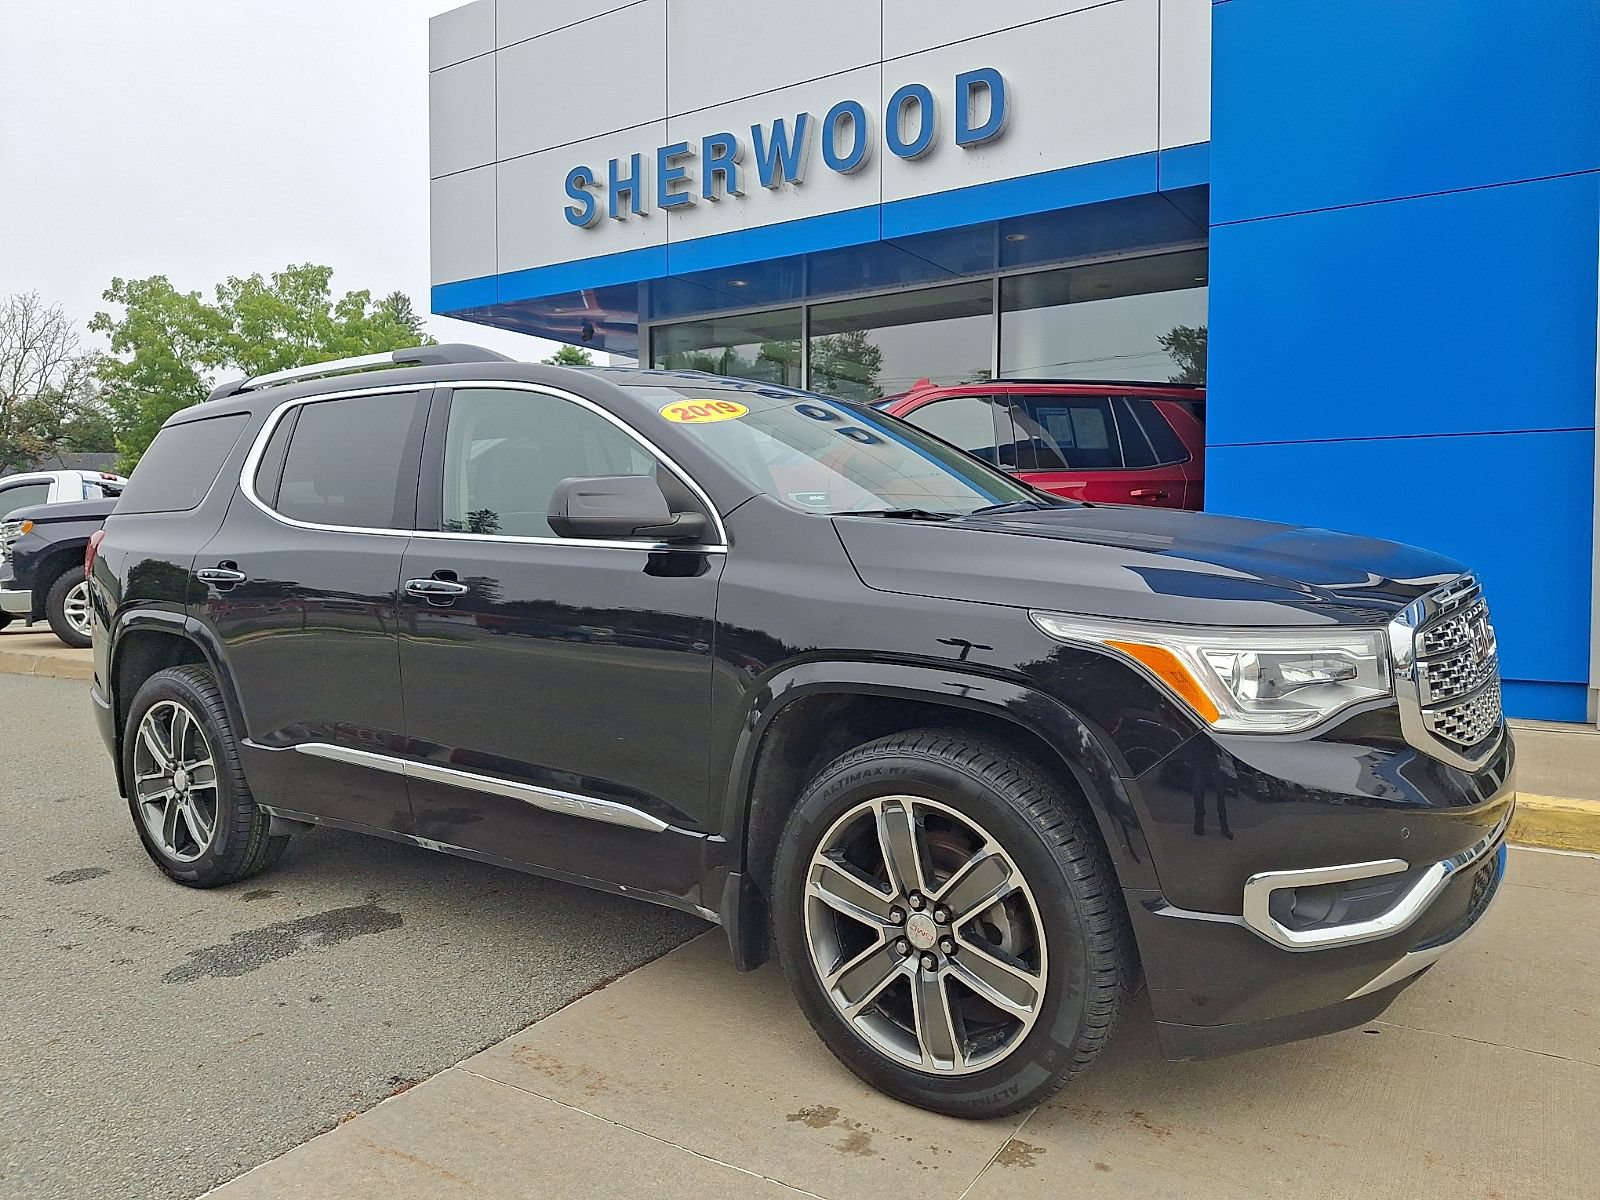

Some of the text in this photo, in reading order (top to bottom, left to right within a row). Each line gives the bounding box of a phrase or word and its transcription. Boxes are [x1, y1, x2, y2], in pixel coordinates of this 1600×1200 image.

[564, 67, 1008, 229] SHERWOOD
[671, 401, 740, 421] 2019
[823, 766, 884, 801] ALTIMAX
[910, 922, 934, 941] GMC
